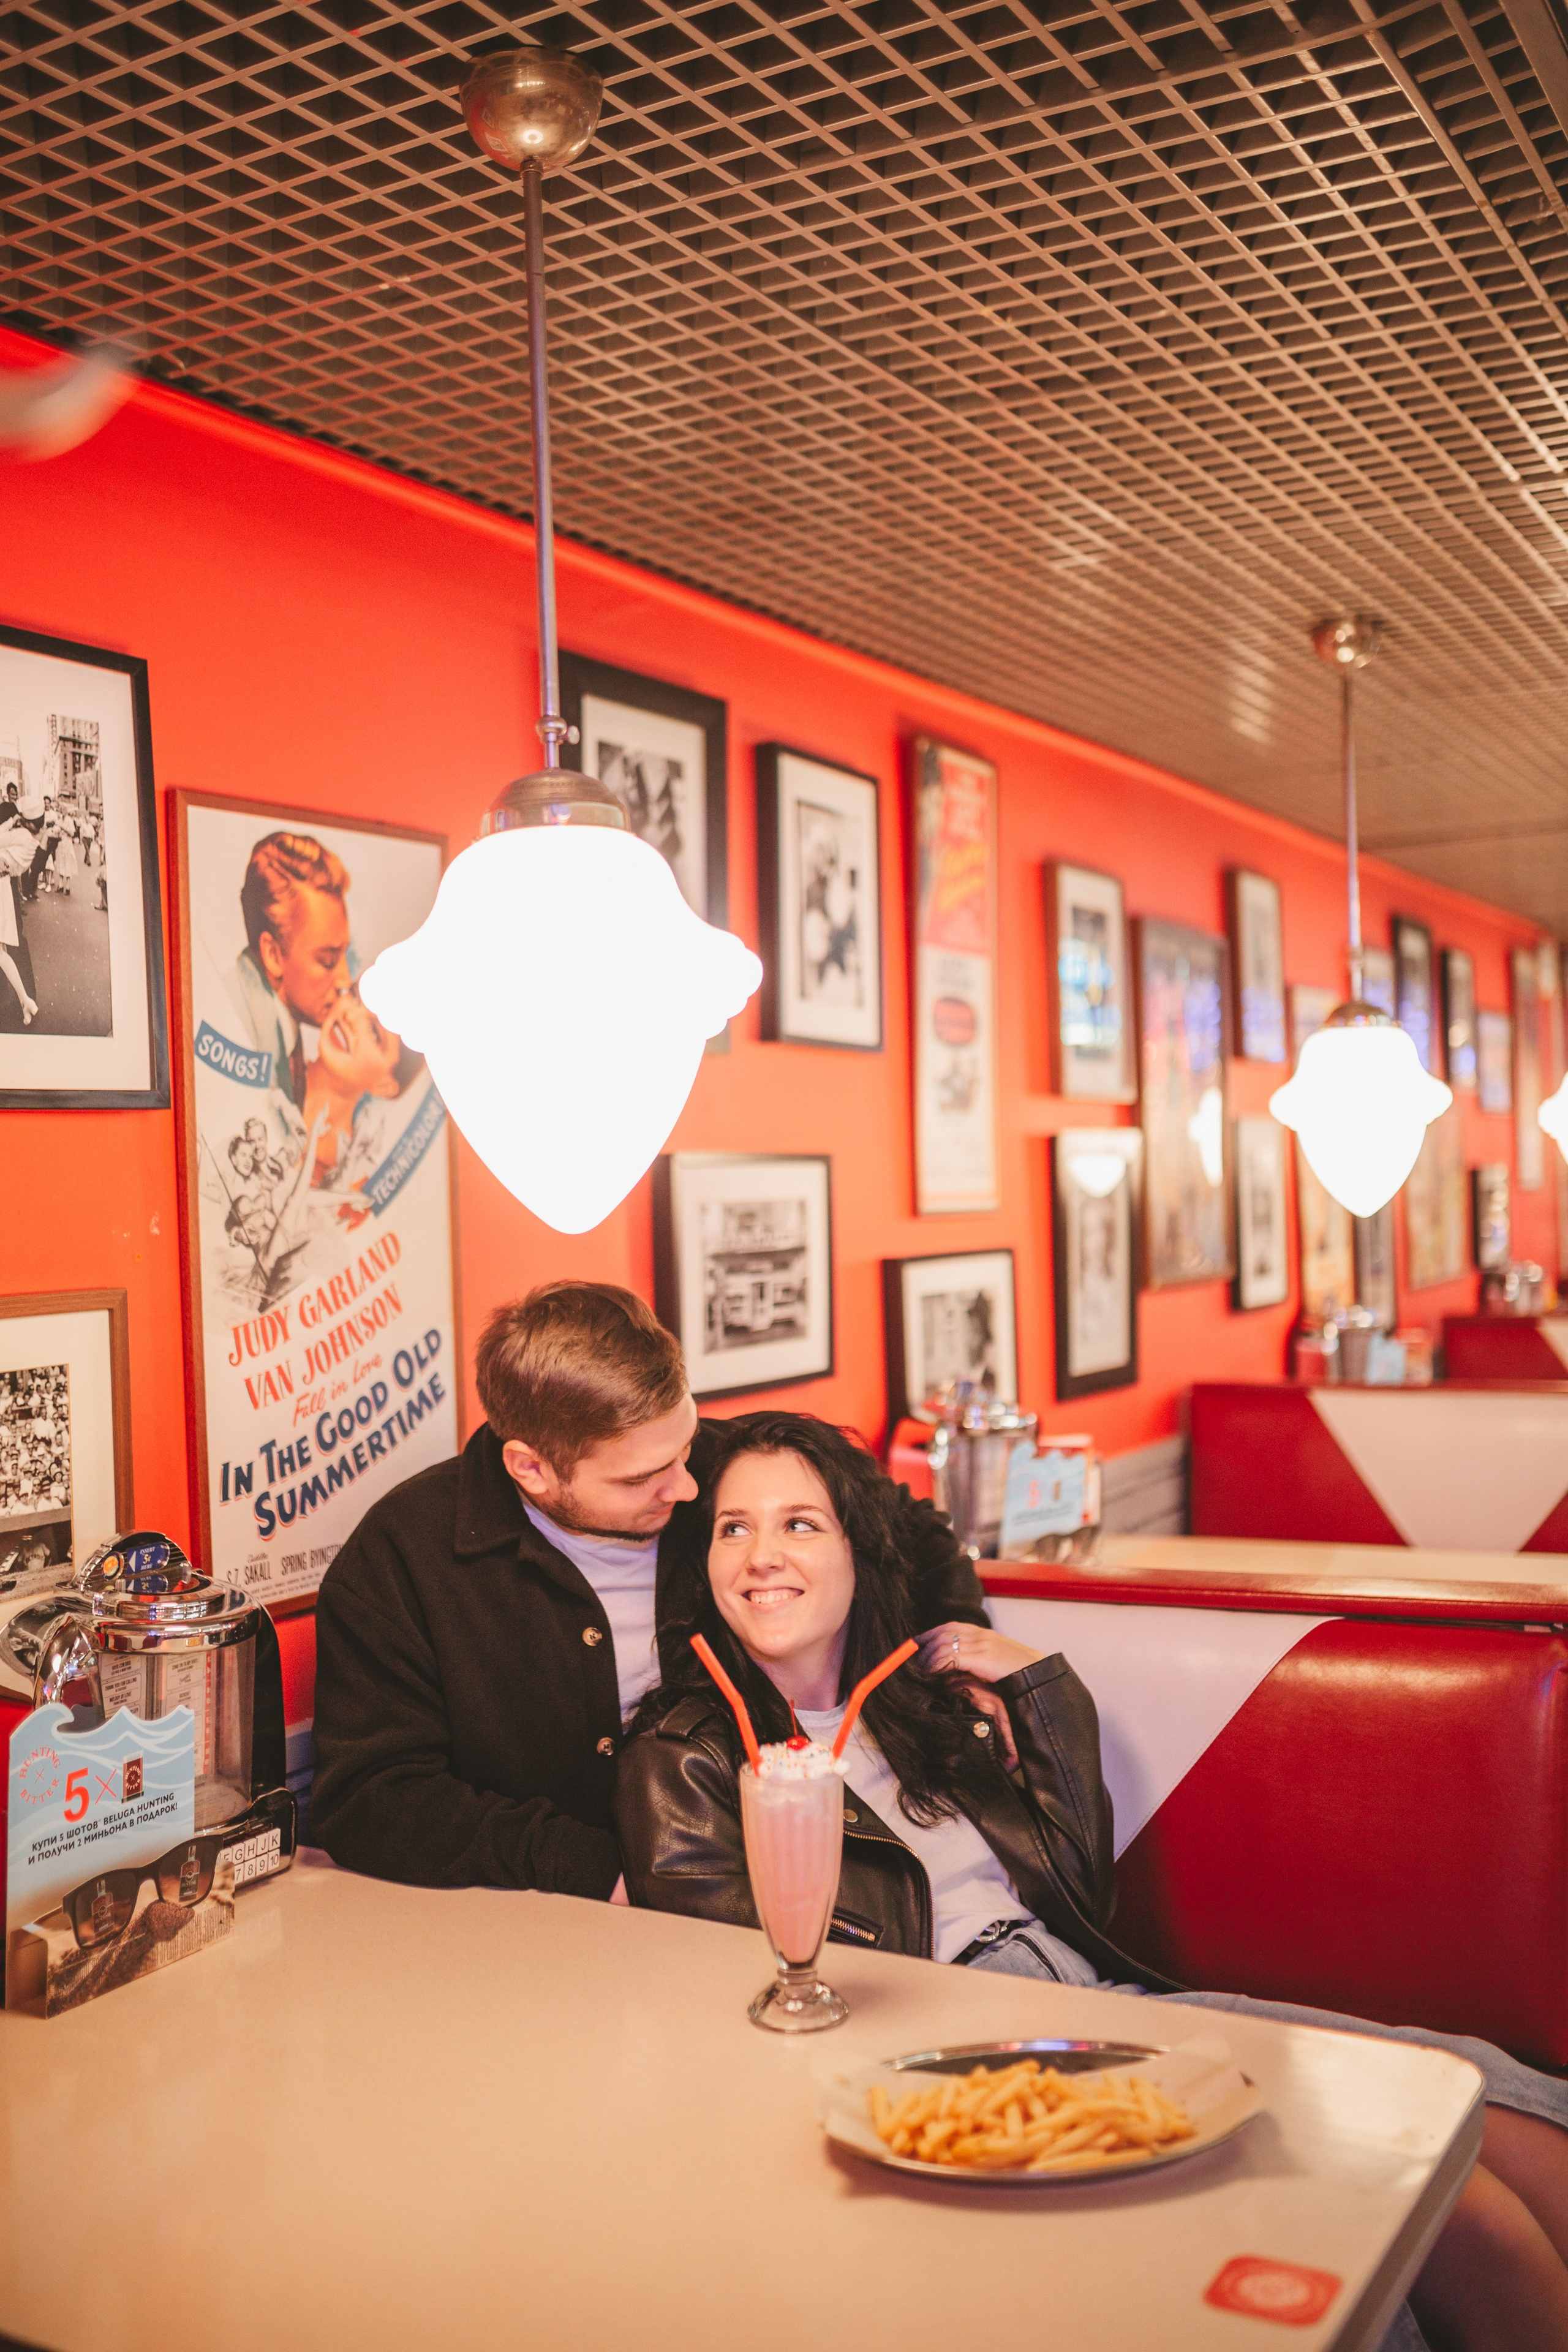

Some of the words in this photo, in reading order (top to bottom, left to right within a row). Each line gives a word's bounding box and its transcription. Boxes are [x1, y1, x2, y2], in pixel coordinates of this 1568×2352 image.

[198, 1034, 268, 1082] SONGS!
[228, 1305, 291, 1367] JUDY
[298, 1231, 401, 1329] GARLAND
[244, 1359, 294, 1411] VAN
[303, 1282, 403, 1385] JOHNSON
[292, 1387, 327, 1428] Fall
[331, 1379, 349, 1400] in
[353, 1354, 383, 1385] Love
[219, 1461, 255, 1506] IN
[259, 1435, 312, 1488] THE
[315, 1381, 390, 1457] GOOD
[392, 1329, 442, 1393] OLD
[254, 1371, 447, 1542] SUMMERTIME
[140, 1547, 156, 1555] INSERT
[244, 1561, 273, 1586] SAKALL
[281, 1552, 307, 1576] SPRING
[109, 1694, 120, 1703] MELODY
[19, 1747, 61, 1779] HUNTING
[20, 1779, 59, 1805] BITTER
[64, 1767, 90, 1823] 5
[28, 1855, 35, 1865] И
[38, 1841, 75, 1862] ПОЛУЧИ
[77, 1839, 82, 1847] 2
[84, 1822, 127, 1845] МИНЬОНА
[129, 1818, 134, 1827] В
[137, 1803, 178, 1825] ПОДАРОК!
[32, 1835, 57, 1852] КУПИ
[59, 1833, 64, 1842] 5
[66, 1820, 98, 1839] ШОТОВ
[104, 1807, 135, 1825] BELUGA
[137, 1793, 175, 1813] HUNTING
[235, 1849, 243, 1861] G
[247, 1844, 255, 1856] H
[261, 1838, 266, 1850] J
[271, 1834, 278, 1846] K
[236, 1868, 241, 1881] 7
[247, 1864, 253, 1875] 8
[259, 1860, 265, 1871] 9
[270, 1853, 279, 1866] 10
